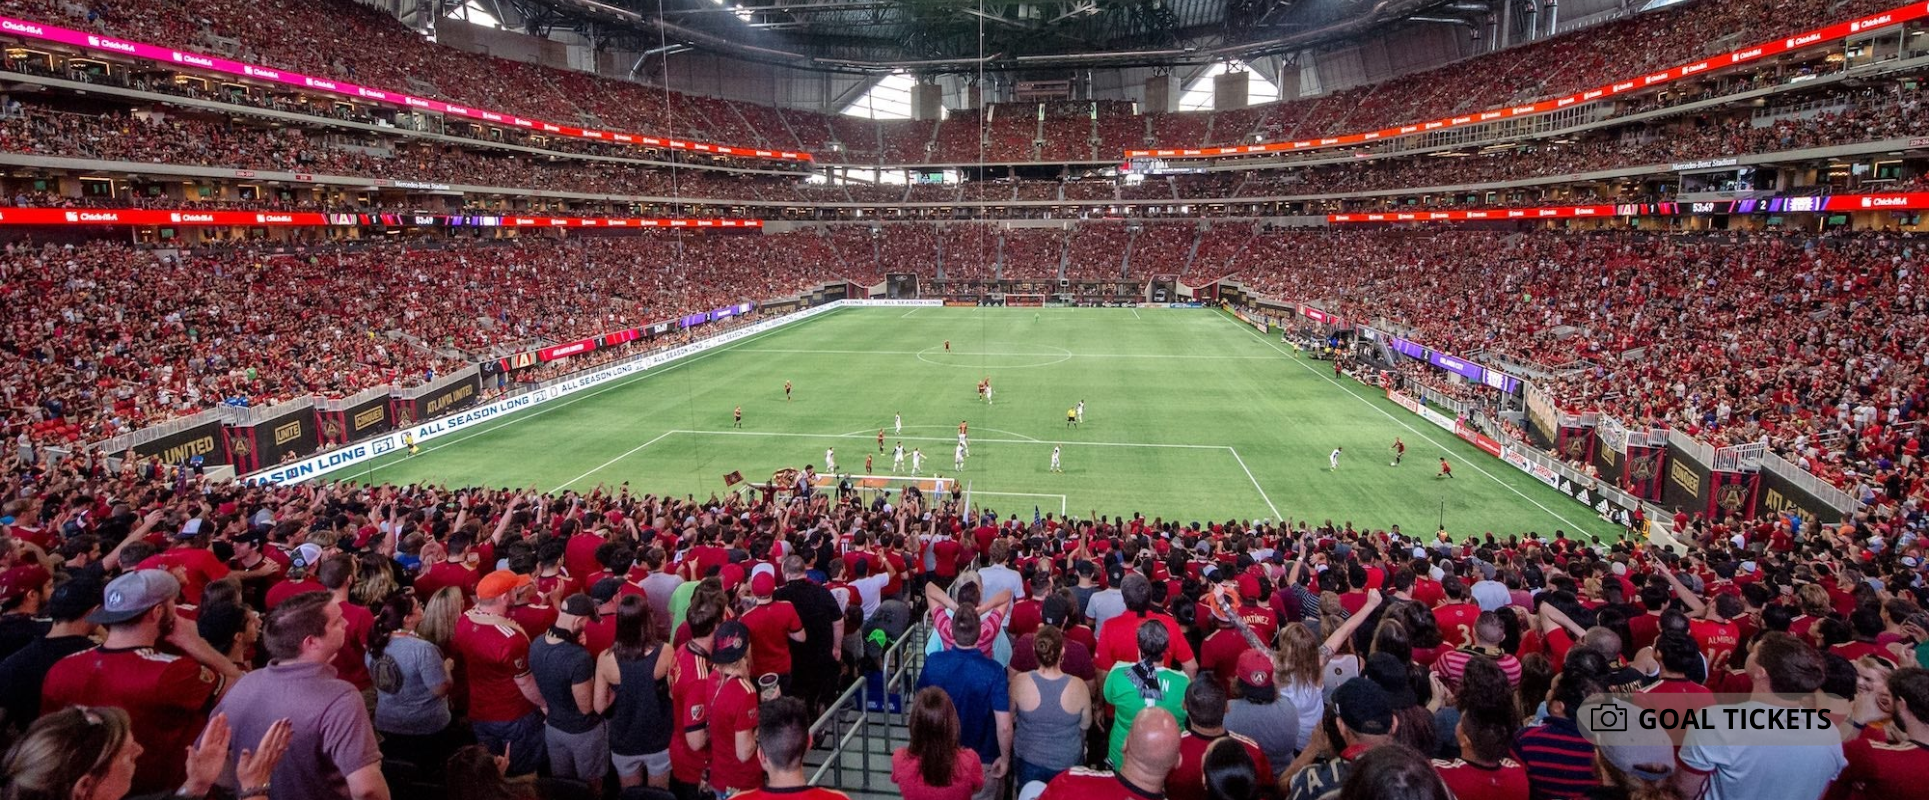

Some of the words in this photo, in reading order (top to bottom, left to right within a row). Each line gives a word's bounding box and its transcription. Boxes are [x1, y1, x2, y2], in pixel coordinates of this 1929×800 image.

[1712, 158, 1737, 167] Stadium
[1760, 200, 1766, 210] 2
[562, 381, 578, 393] ALL
[580, 370, 612, 387] SEASON
[613, 364, 632, 376] LONG
[426, 394, 452, 414] ATLANTA
[452, 384, 473, 403] UNITED
[420, 424, 445, 438] ALL
[448, 406, 498, 428] SEASON
[500, 396, 529, 412] LONG
[277, 424, 300, 442] UNITE
[164, 435, 214, 465] UNITED
[318, 446, 366, 470] LONG
[1456, 624, 1472, 649] 3
